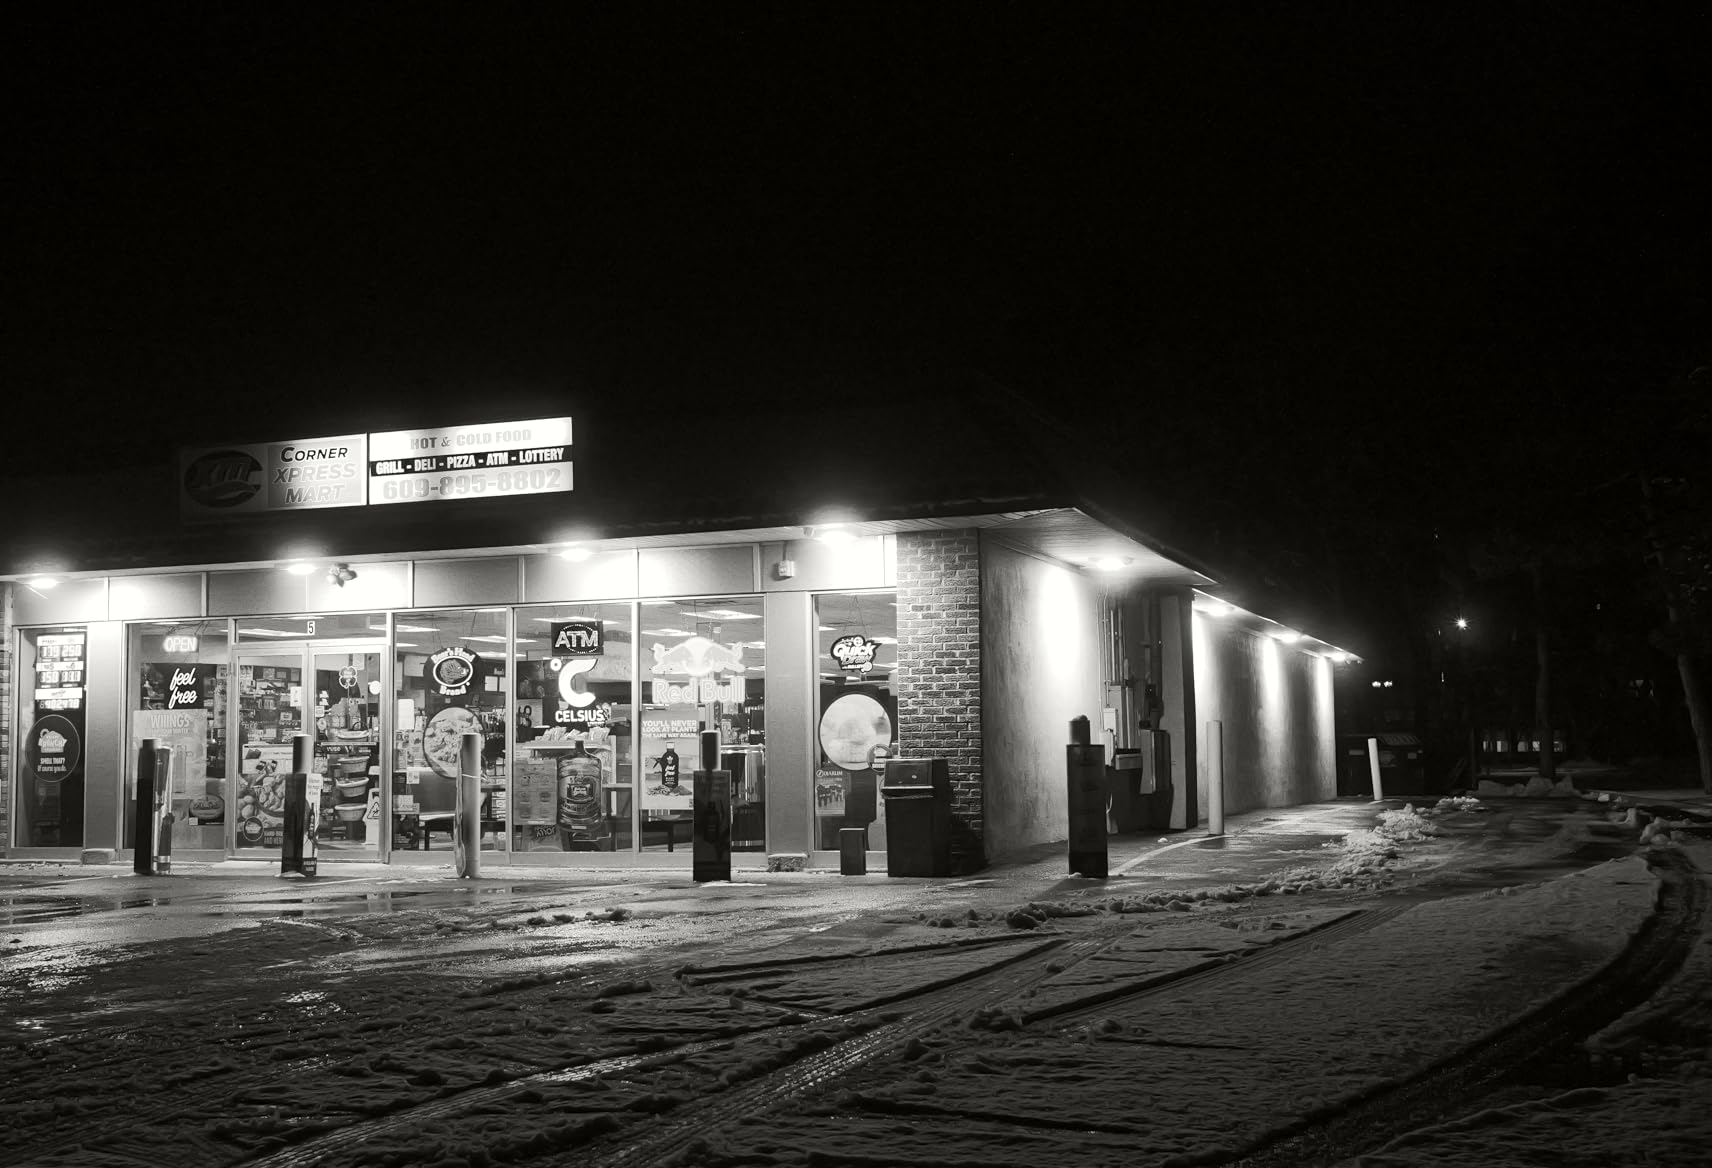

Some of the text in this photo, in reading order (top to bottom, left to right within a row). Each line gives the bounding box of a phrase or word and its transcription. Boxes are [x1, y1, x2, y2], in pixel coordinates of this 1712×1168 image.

[410, 428, 532, 450] HOT & COLD FOOD
[376, 460, 405, 475] GRILL
[414, 457, 437, 472] DELI
[446, 454, 476, 469] PIZZA
[486, 451, 509, 466] ATM
[519, 447, 564, 464] LOTTERY
[273, 463, 357, 484] XPRESS
[285, 484, 345, 504] MART
[383, 468, 561, 500] 609-895-8802
[308, 621, 315, 635] 5
[163, 635, 198, 652] OPEN
[555, 630, 599, 648] ATM
[169, 667, 196, 691] feel
[168, 686, 198, 710] free
[439, 685, 467, 696] Brand
[652, 676, 746, 704] Red Bull
[555, 709, 604, 723] CELSIUS
[671, 719, 697, 727] NEVER
